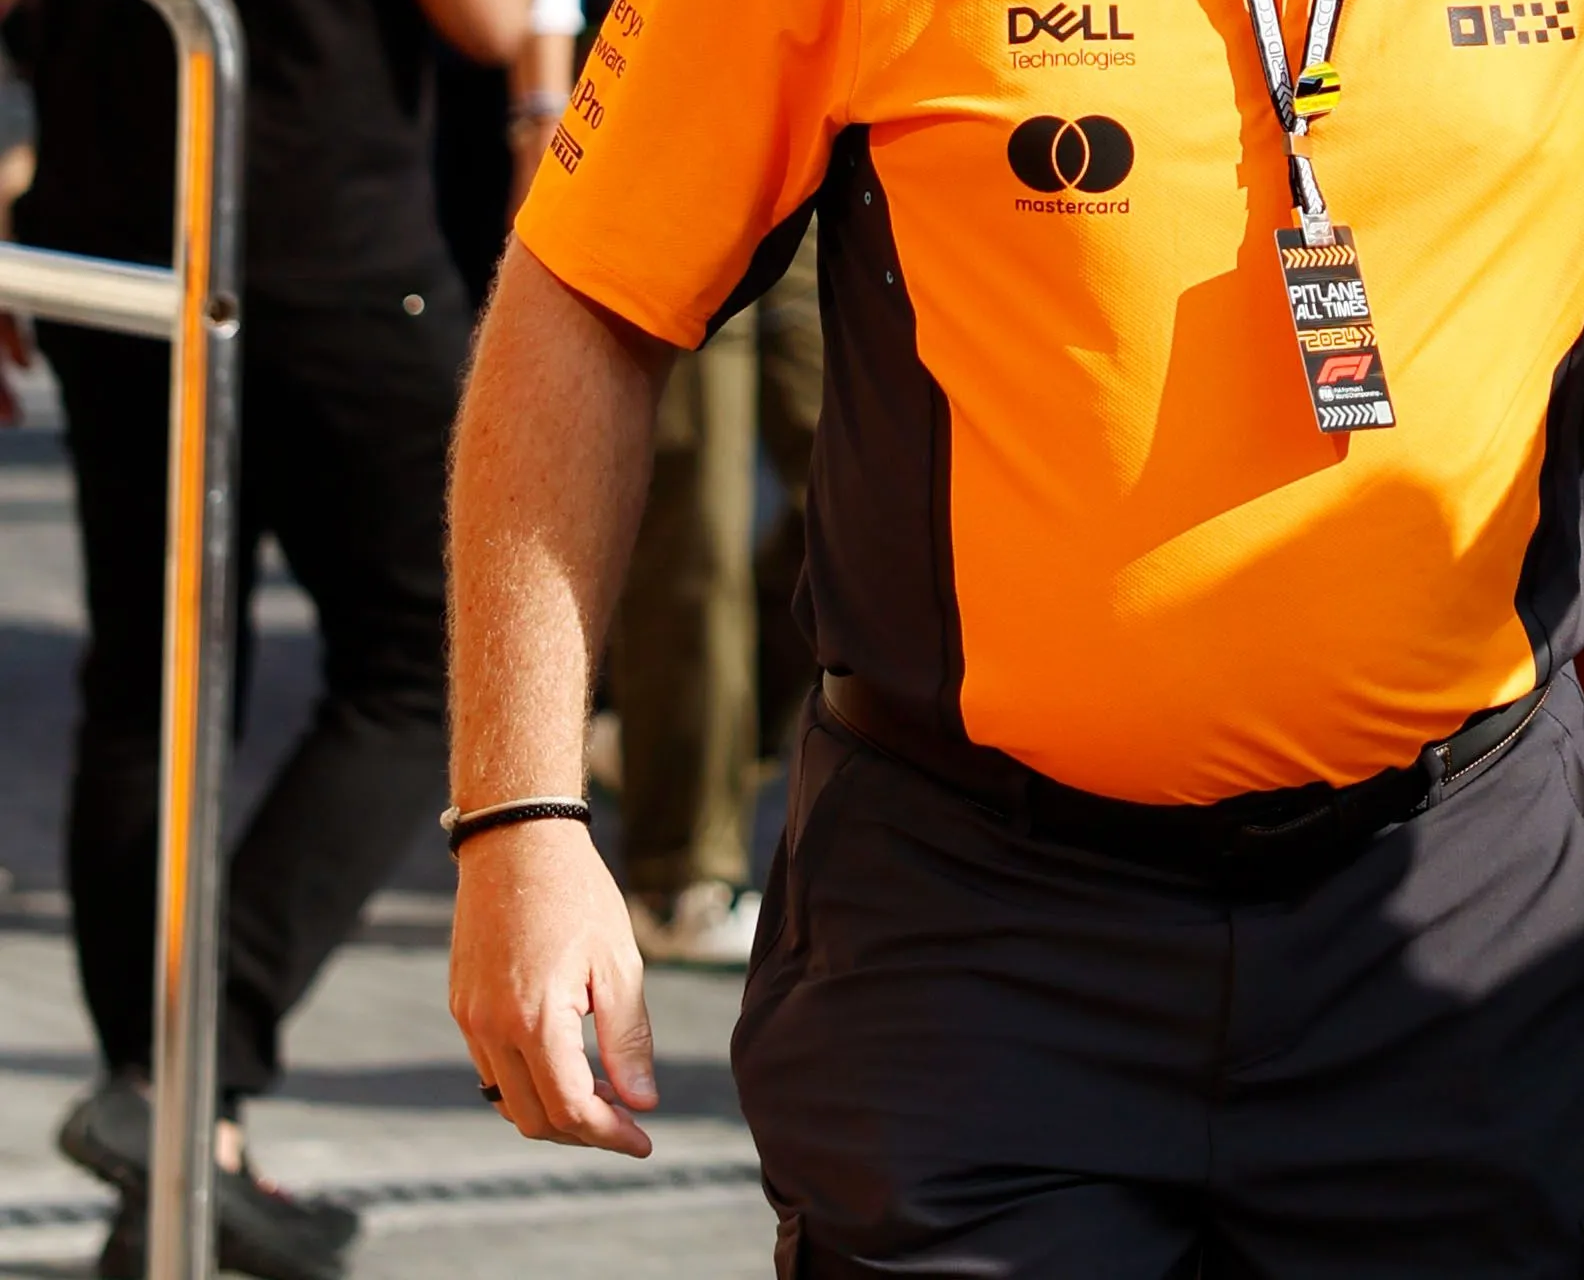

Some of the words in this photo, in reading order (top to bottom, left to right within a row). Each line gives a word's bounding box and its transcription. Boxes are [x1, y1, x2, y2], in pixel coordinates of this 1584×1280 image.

[1007, 2, 1135, 45] DELL
[1008, 48, 1137, 71] Technologies
[550, 133, 579, 176] RELLI
[1015, 198, 1130, 215] mastercard
[1289, 282, 1366, 305] PITLANE
[1297, 303, 1323, 320] ALL
[1324, 300, 1368, 317] TIMES
[1308, 328, 1360, 347] 2024
[1316, 353, 1374, 385] F1
